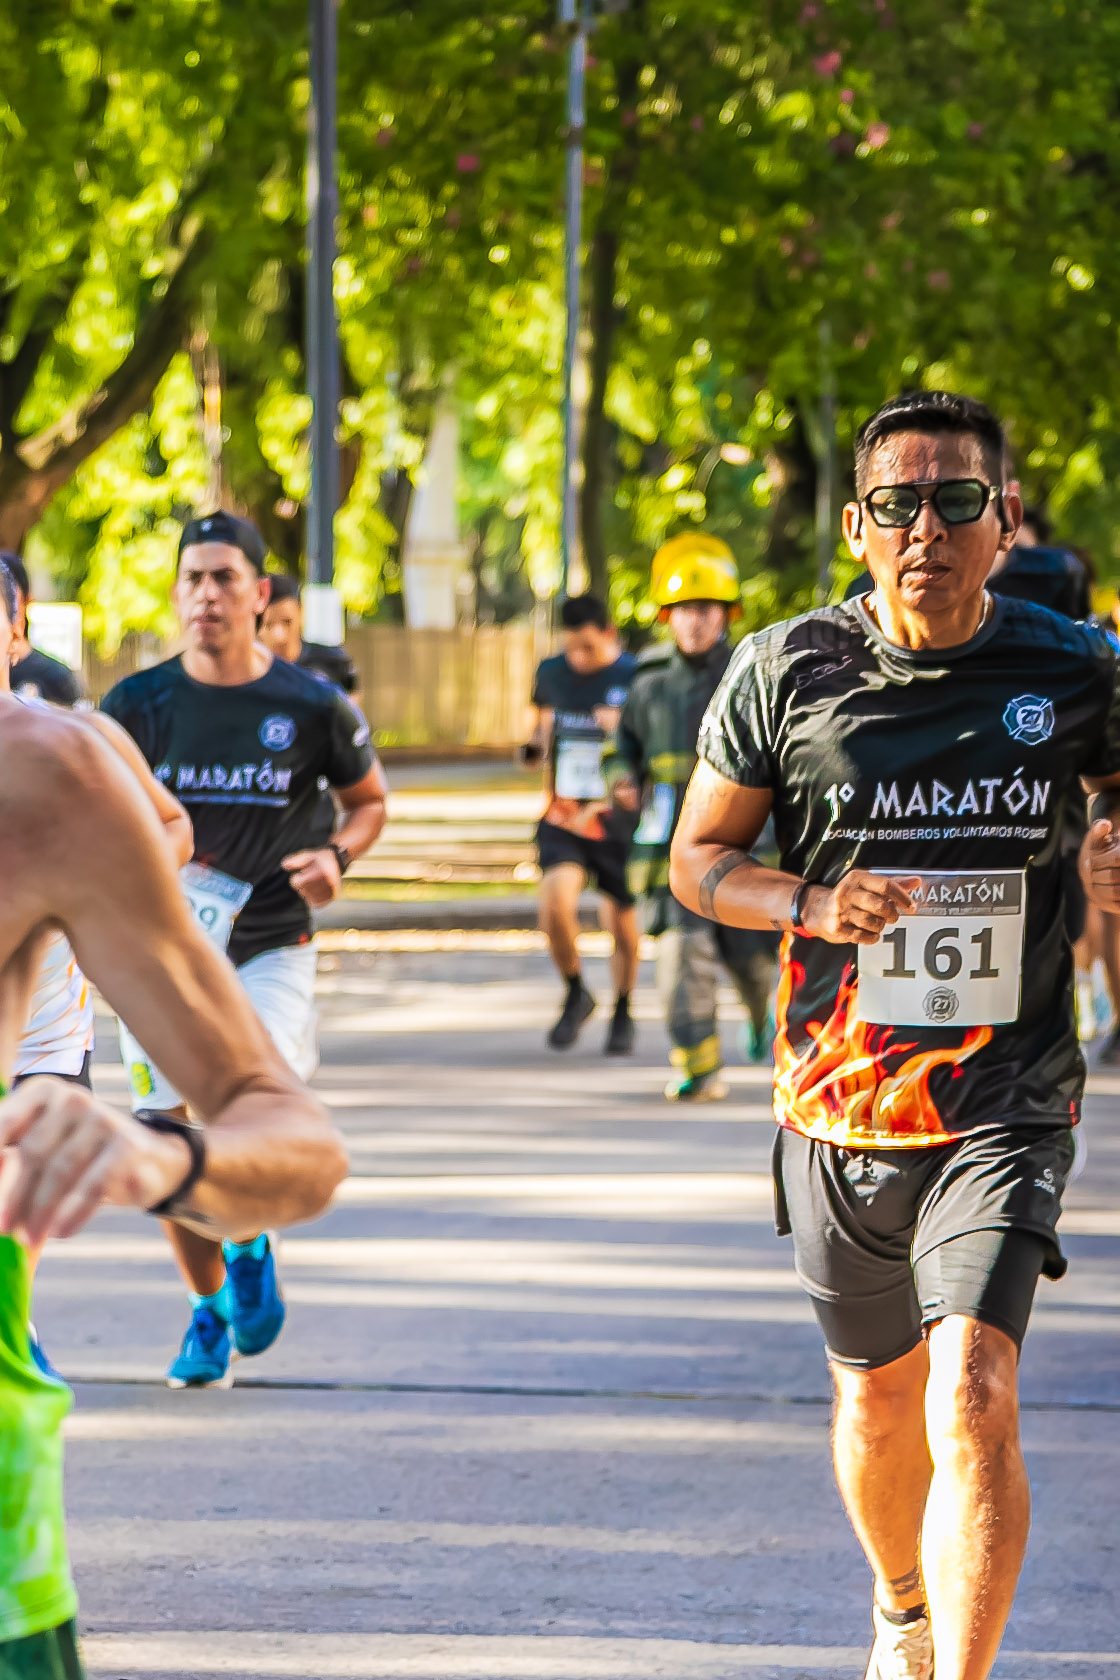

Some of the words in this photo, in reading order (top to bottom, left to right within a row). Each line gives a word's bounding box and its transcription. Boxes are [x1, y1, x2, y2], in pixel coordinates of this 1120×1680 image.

[870, 766, 1051, 819] MARATÓN
[878, 827, 940, 841] BOMBEROS
[943, 826, 1013, 839] VOLUNTARIOS
[910, 878, 1005, 903] MARATÓN
[883, 928, 999, 980] 161
